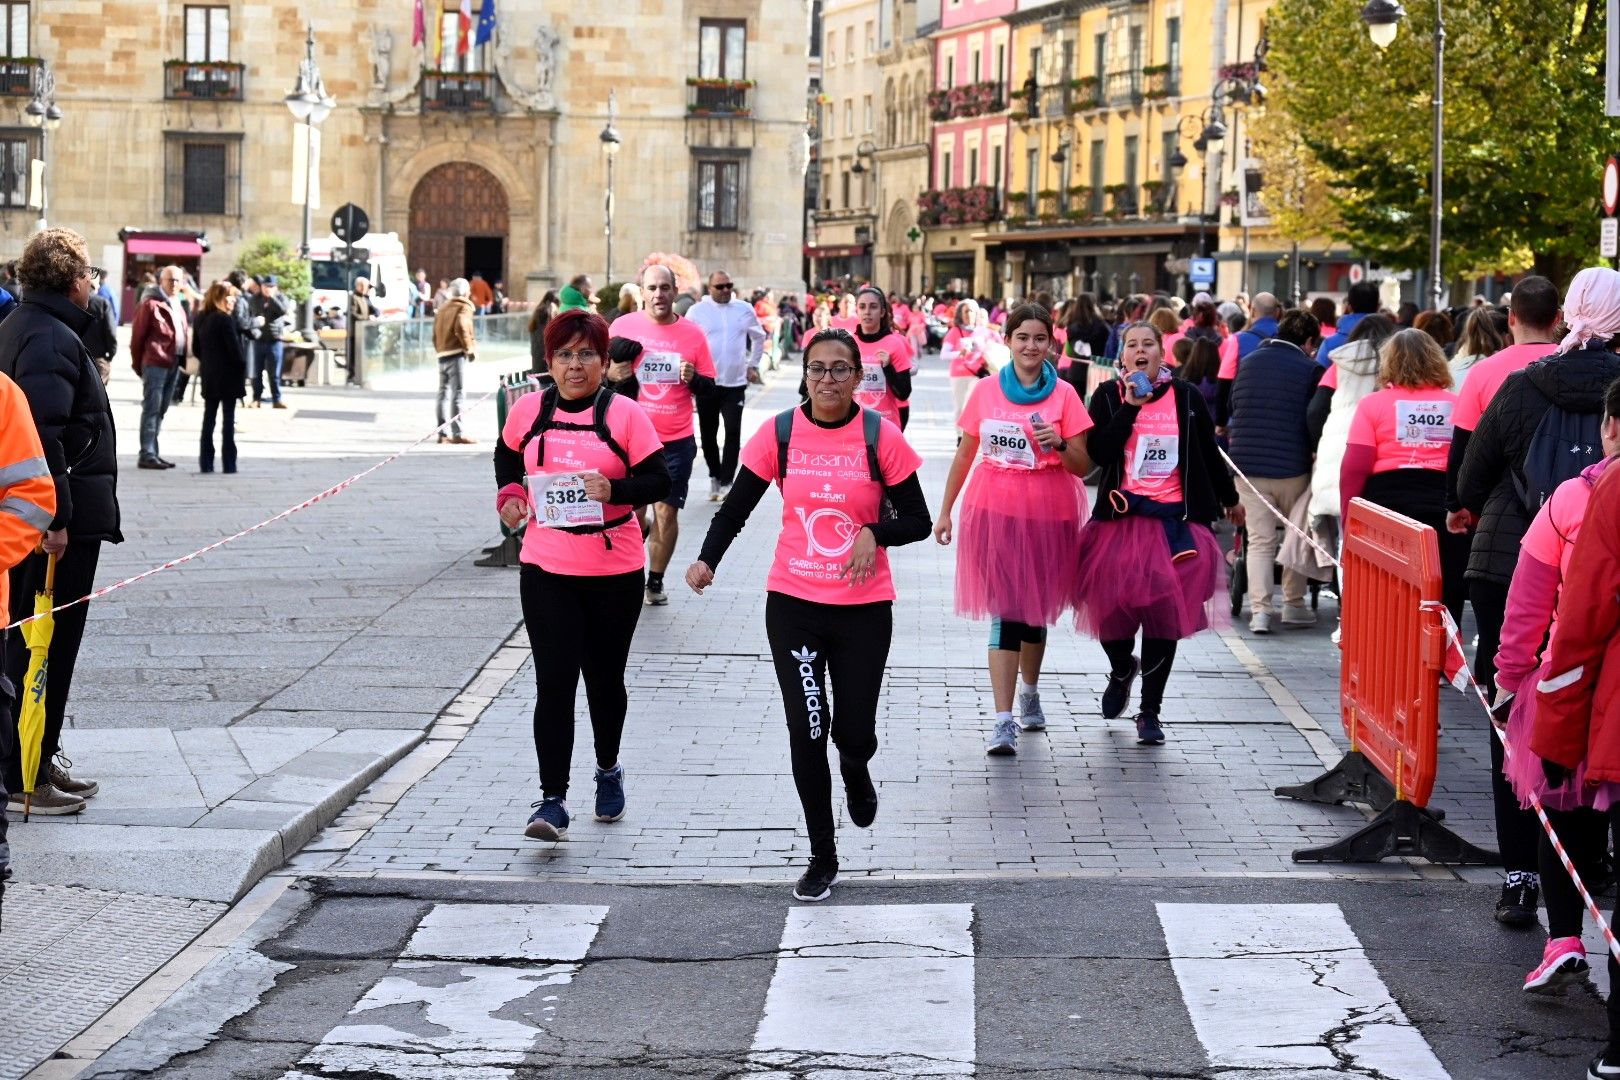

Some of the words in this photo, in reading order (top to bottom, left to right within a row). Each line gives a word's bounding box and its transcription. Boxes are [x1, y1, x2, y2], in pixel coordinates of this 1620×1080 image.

[644, 363, 672, 372] 5270
[861, 373, 878, 382] 58
[1408, 414, 1445, 426] 3402
[990, 434, 1027, 450] 3860
[791, 448, 865, 467] Drasanvi
[546, 489, 588, 505] 5382
[809, 491, 846, 500] SUZUKI
[789, 557, 825, 571] CARRERA
[826, 562, 838, 571] DE
[798, 662, 822, 740] adidas
